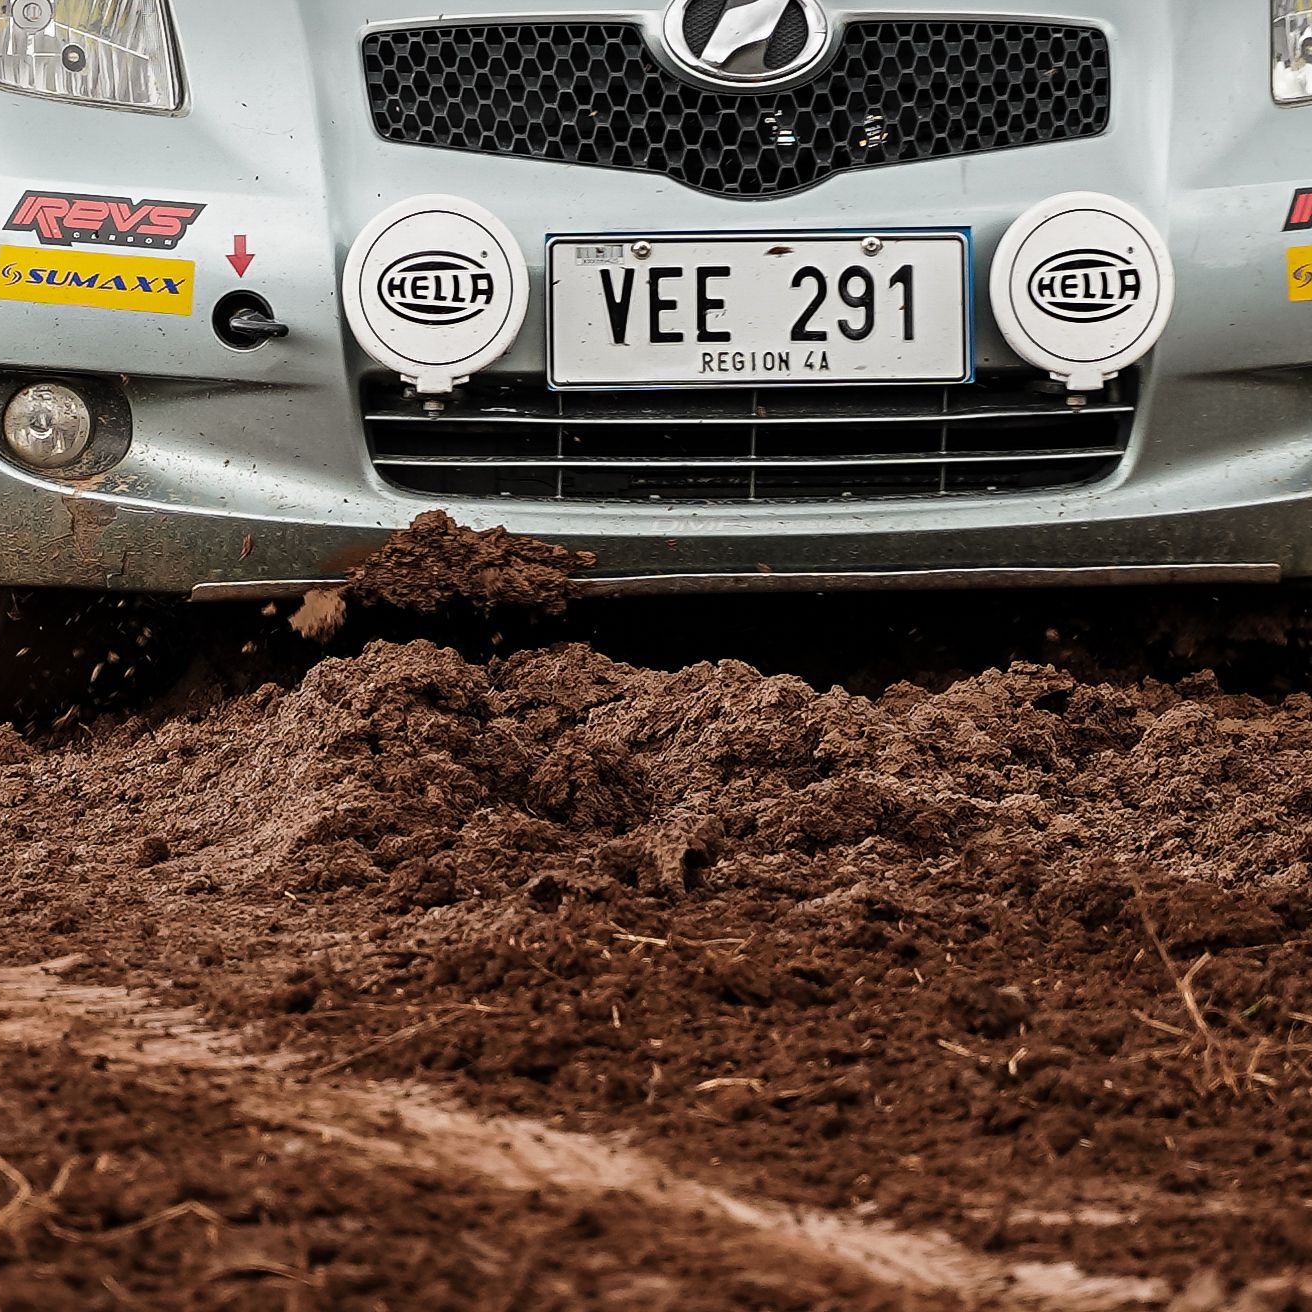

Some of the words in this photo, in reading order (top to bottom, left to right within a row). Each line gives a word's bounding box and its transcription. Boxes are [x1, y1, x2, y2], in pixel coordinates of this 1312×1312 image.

[24, 268, 186, 295] SUMAXX
[387, 272, 494, 305] HELLA
[1037, 268, 1141, 300] HELLA
[600, 266, 732, 344] VEE
[790, 264, 915, 342] 291
[700, 351, 790, 372] REGION
[804, 350, 830, 371] 4A
